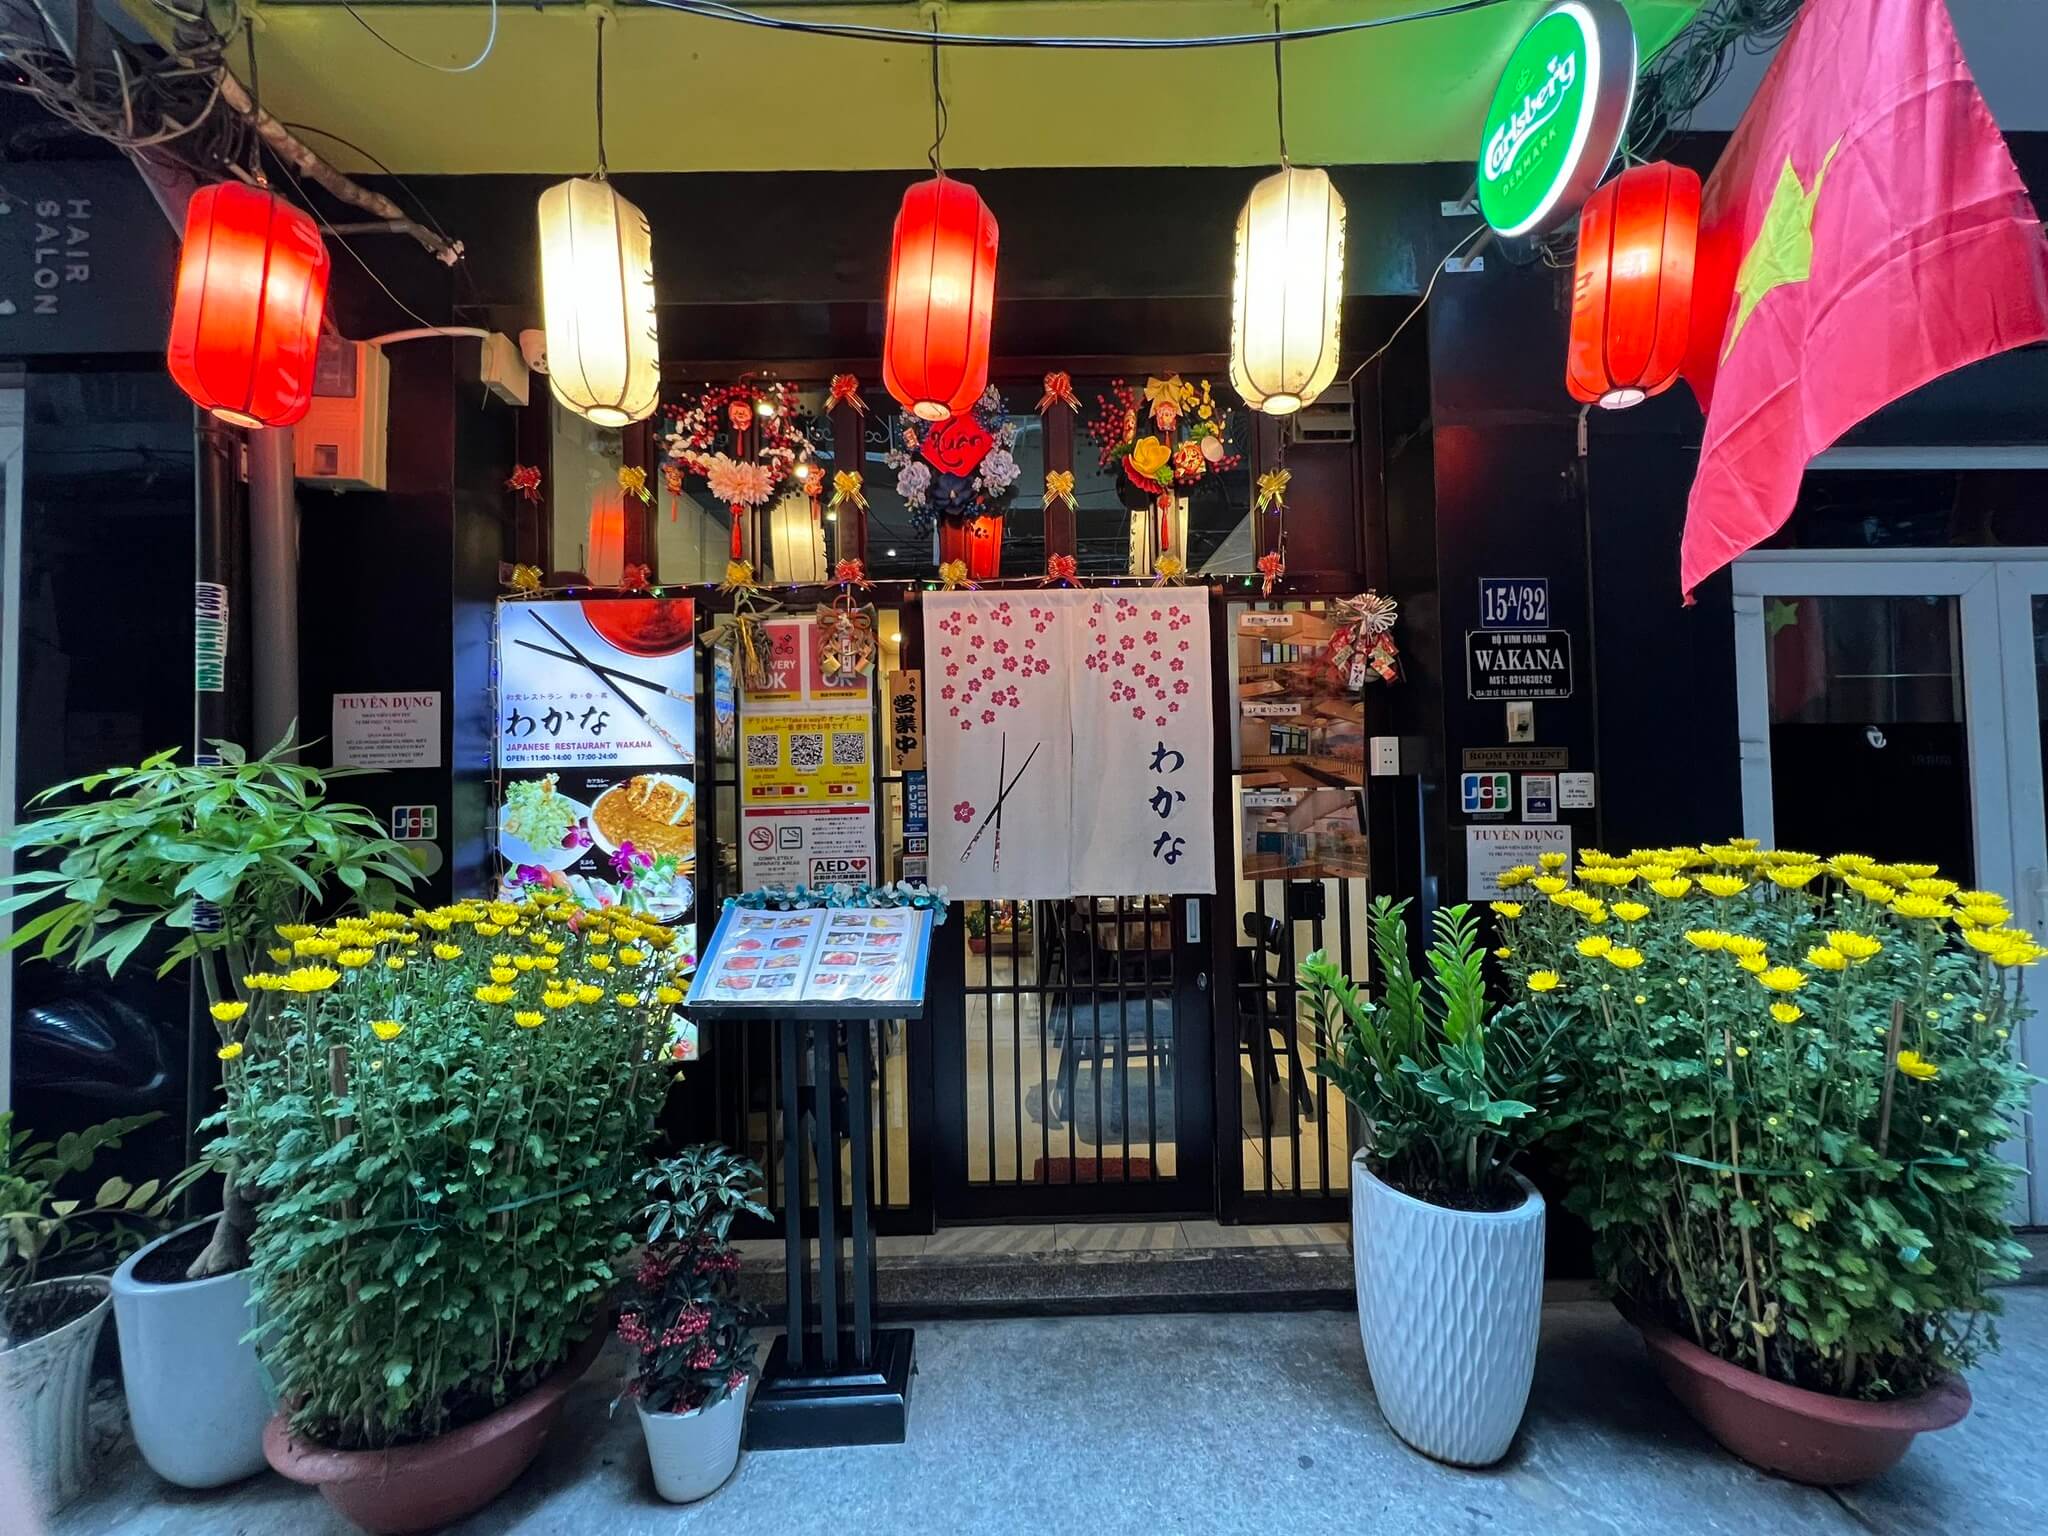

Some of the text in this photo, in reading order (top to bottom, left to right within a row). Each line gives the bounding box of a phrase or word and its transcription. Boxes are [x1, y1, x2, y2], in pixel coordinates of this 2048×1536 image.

[1484, 50, 1576, 182] Carlsberg
[1502, 125, 1558, 196] DENMARK
[33, 200, 61, 315] SALON
[66, 199, 92, 284] HAIR
[1485, 585, 1546, 621] 15A/32
[1475, 648, 1565, 671] WAKANA
[392, 696, 434, 711] DỤNG
[505, 705, 611, 737] わかな
[893, 693, 918, 754] 営業中
[506, 740, 652, 752] JAPANESE RESTAURANT WAKANA
[530, 753, 572, 762] 11:00-14:00
[576, 752, 618, 761] 17:00-24:00
[908, 784, 918, 818] PUSH
[1148, 741, 1186, 865] わかな
[1523, 829, 1565, 843] DỤNG
[814, 859, 850, 873] AED
